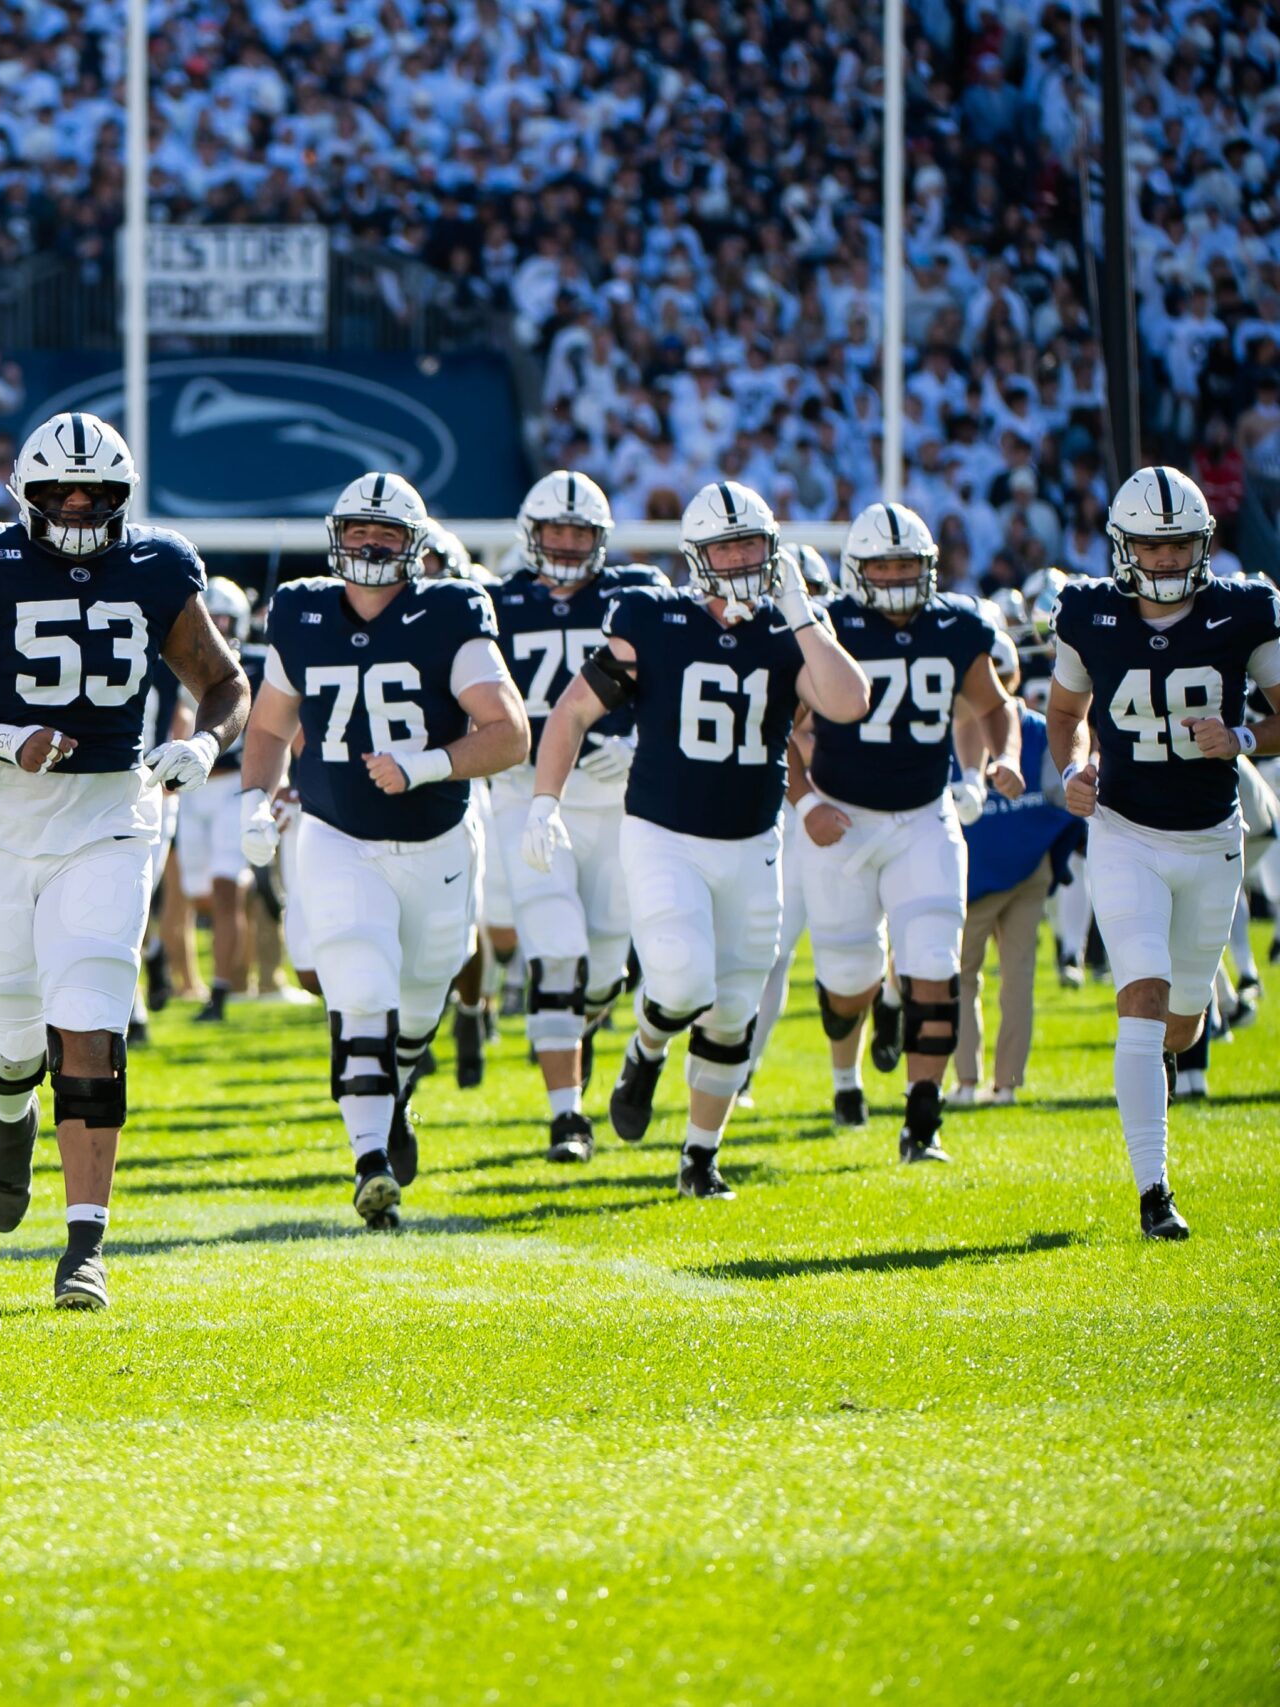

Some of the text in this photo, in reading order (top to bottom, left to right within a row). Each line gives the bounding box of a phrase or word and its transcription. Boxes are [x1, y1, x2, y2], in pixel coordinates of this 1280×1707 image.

[14, 598, 149, 707] 53
[857, 656, 956, 744] 79
[305, 662, 429, 763] 76
[679, 661, 770, 765] 61
[1108, 665, 1224, 762] 48
